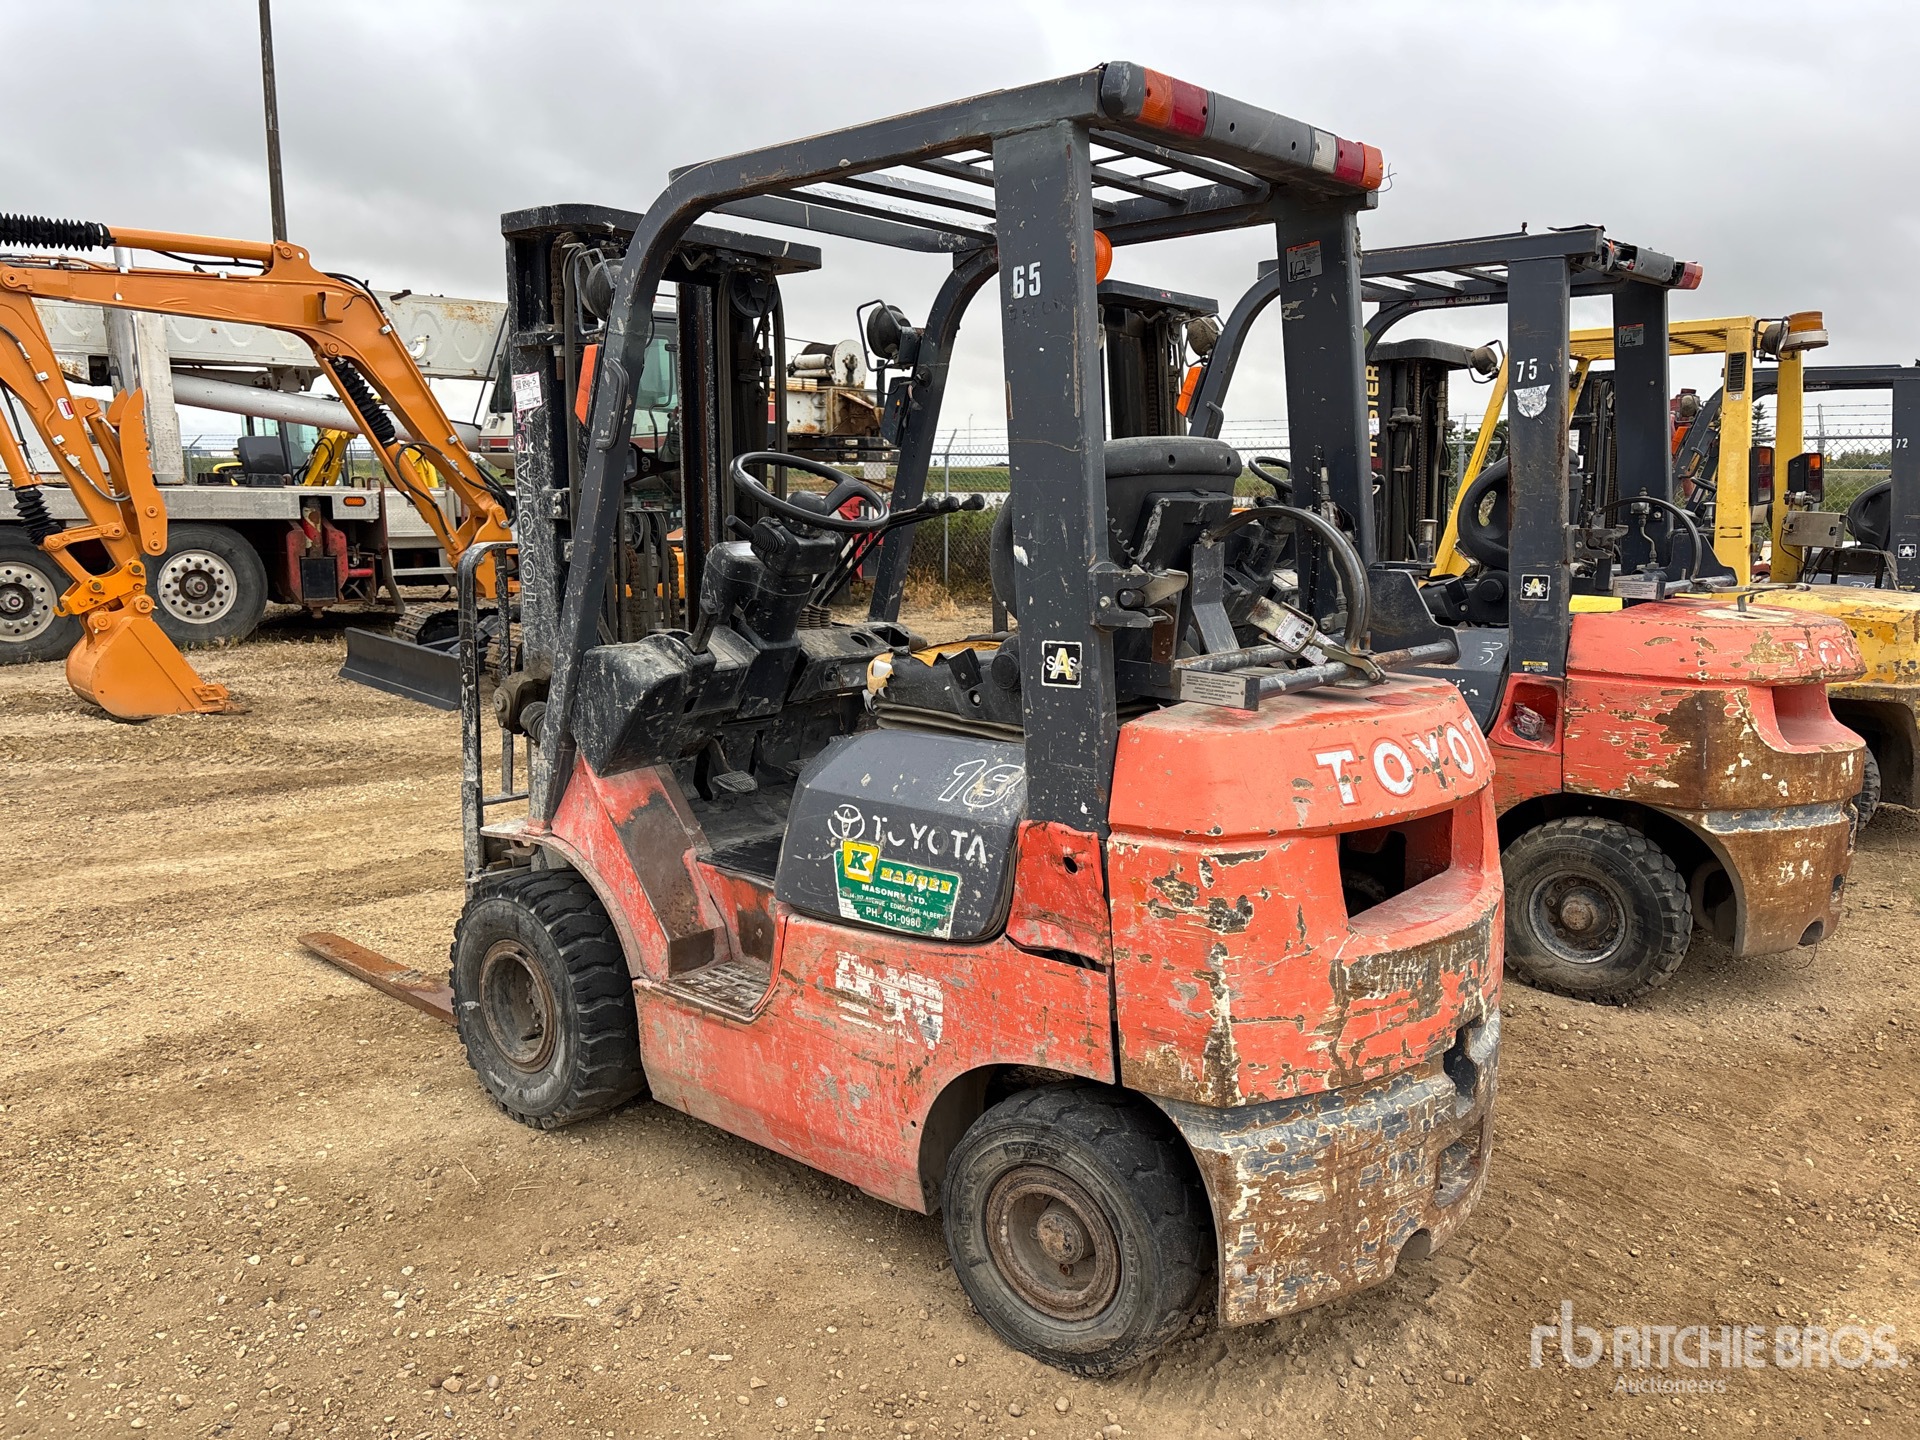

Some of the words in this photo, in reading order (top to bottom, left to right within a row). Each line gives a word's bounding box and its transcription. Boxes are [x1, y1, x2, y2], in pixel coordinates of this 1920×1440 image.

[1012, 261, 1041, 299] 65
[1516, 358, 1538, 383] 75
[1895, 438, 1909, 449] 72
[515, 458, 538, 608] TOYOTA
[1523, 577, 1547, 597] SAS
[1046, 647, 1077, 681] SAS
[847, 849, 873, 876] K
[880, 867, 953, 895] HANSEN
[907, 893, 927, 906] LTD.
[882, 910, 922, 929] 451-0980
